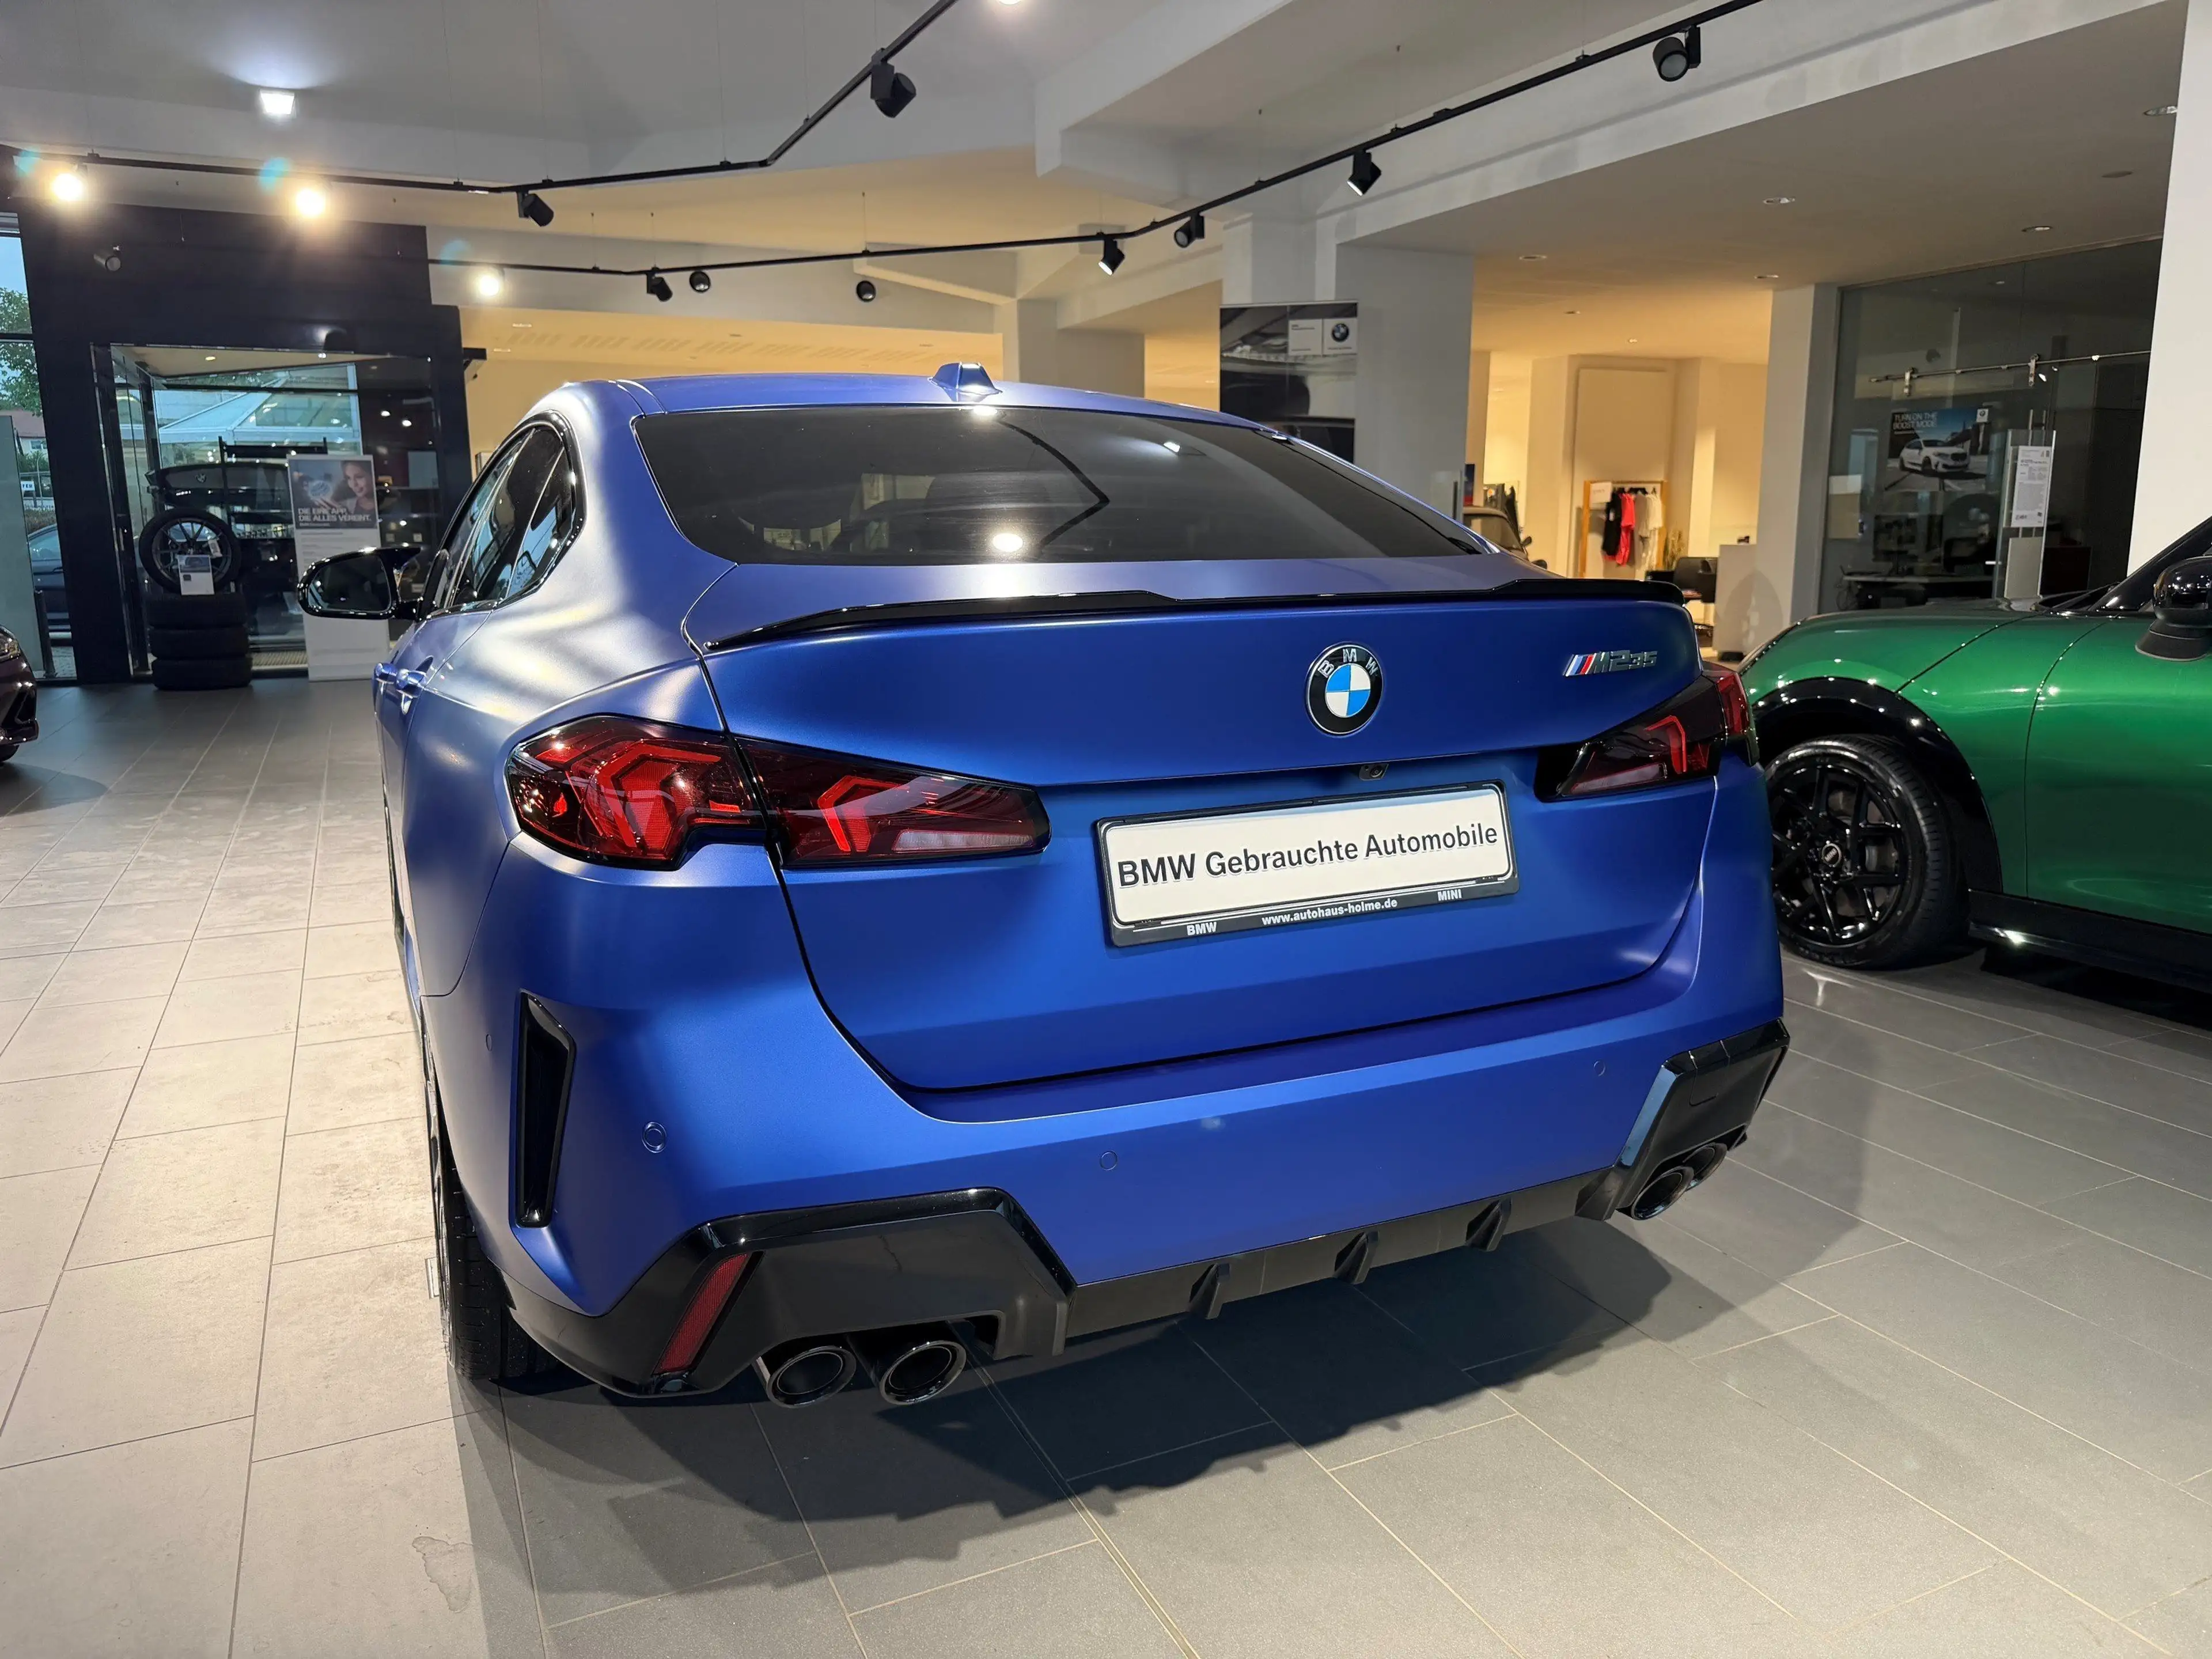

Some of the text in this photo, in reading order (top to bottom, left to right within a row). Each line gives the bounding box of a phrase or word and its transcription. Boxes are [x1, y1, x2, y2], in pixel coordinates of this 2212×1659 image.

[1317, 648, 1379, 679] BMW
[1584, 650, 1658, 675] M235
[1118, 823, 1498, 887] BMW Gebrauchte Automobile
[1187, 889, 1462, 935] BMW www.autohaus-holme.de MINI
